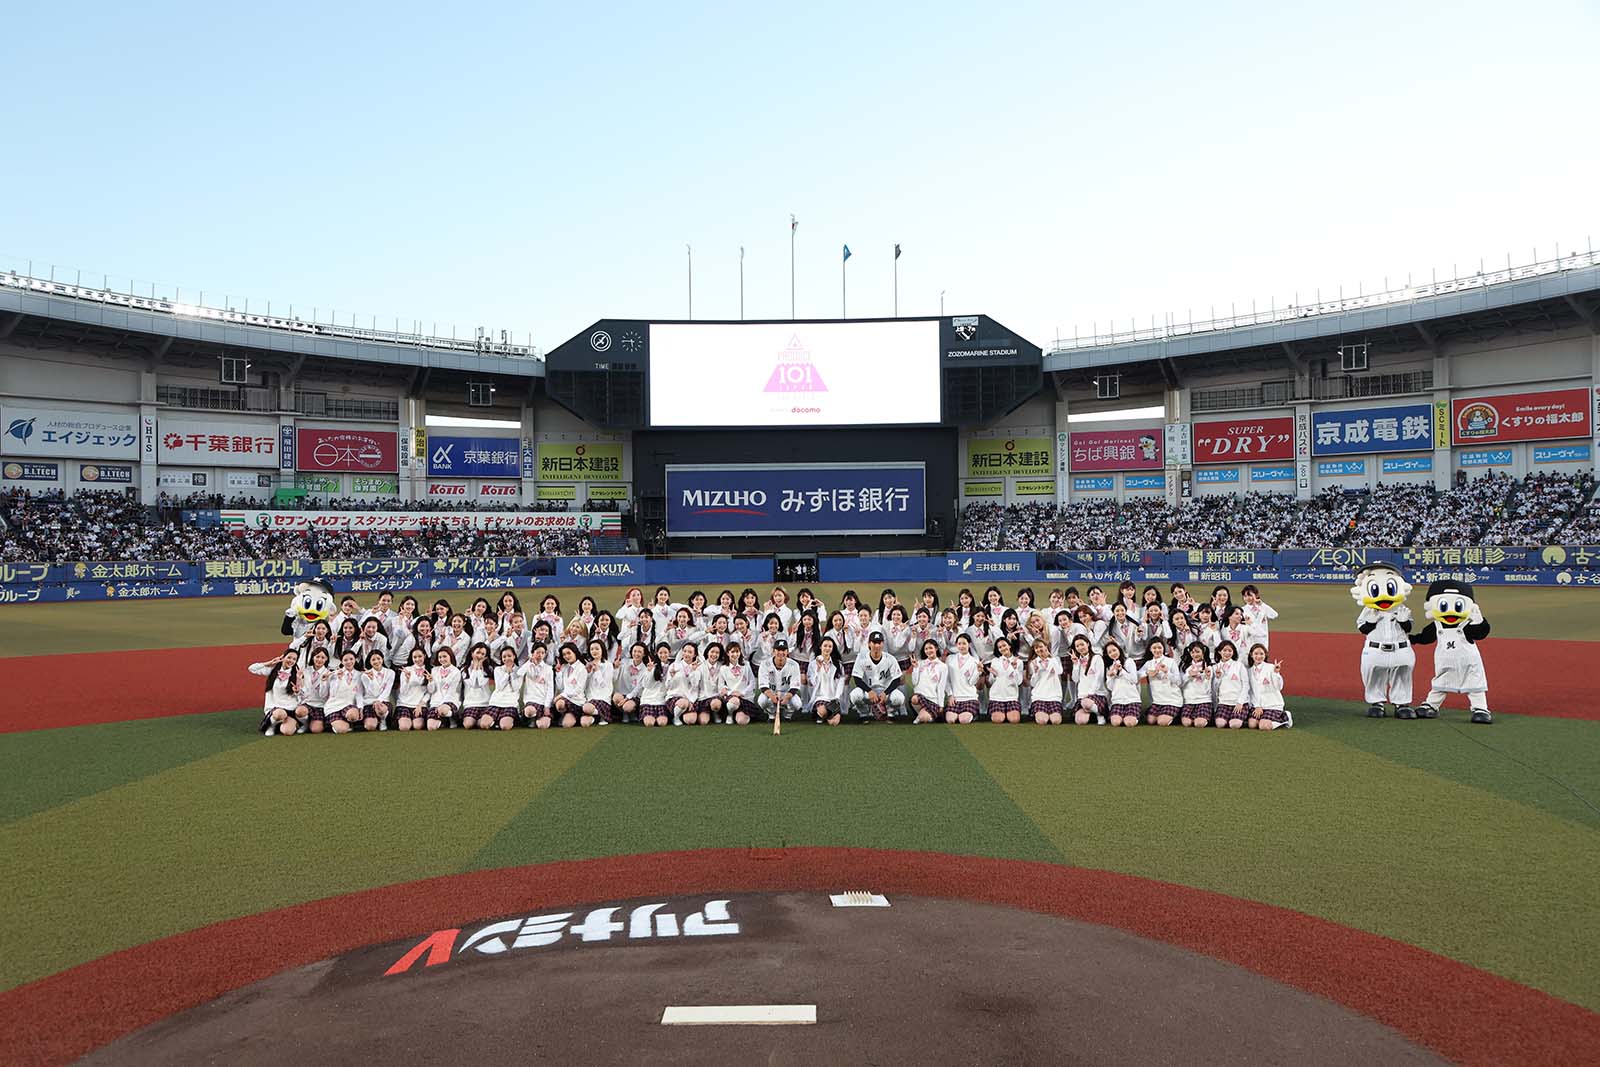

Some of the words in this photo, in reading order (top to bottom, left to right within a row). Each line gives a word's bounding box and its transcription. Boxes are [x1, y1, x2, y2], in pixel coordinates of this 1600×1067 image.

[779, 366, 813, 384] 101
[1501, 411, 1584, 428] くすりの福太郎
[1227, 425, 1264, 435] SUPER
[1298, 415, 1307, 446] 京成バス
[1316, 415, 1430, 445] 京成電鉄
[42, 430, 137, 447] エイジェック
[185, 434, 275, 454] 千葉銀行
[463, 450, 518, 465] 京葉銀行
[971, 451, 1050, 468] 新日本建設
[1073, 445, 1136, 462] ちば興銀
[541, 457, 619, 471] 新日本建設
[682, 489, 767, 507] MIZUHO
[780, 487, 910, 512] みずほ銀行
[1097, 550, 1142, 563] 田所商店
[1206, 550, 1255, 564] 新昭和
[1571, 546, 1600, 565] 古
[91, 563, 182, 579] 金太郎ホーム
[205, 560, 304, 577] 東進ハイスクール
[320, 559, 419, 575] 東京インテリア
[583, 563, 631, 574] KAKUTA
[975, 563, 1021, 572] 三井住友銀行
[467, 577, 514, 588] アインズホーム
[1094, 570, 1132, 581] 田所商店
[1200, 572, 1232, 581] 新昭和
[118, 586, 179, 598] 金太郎ホーム
[351, 580, 413, 591] 東京インテリア
